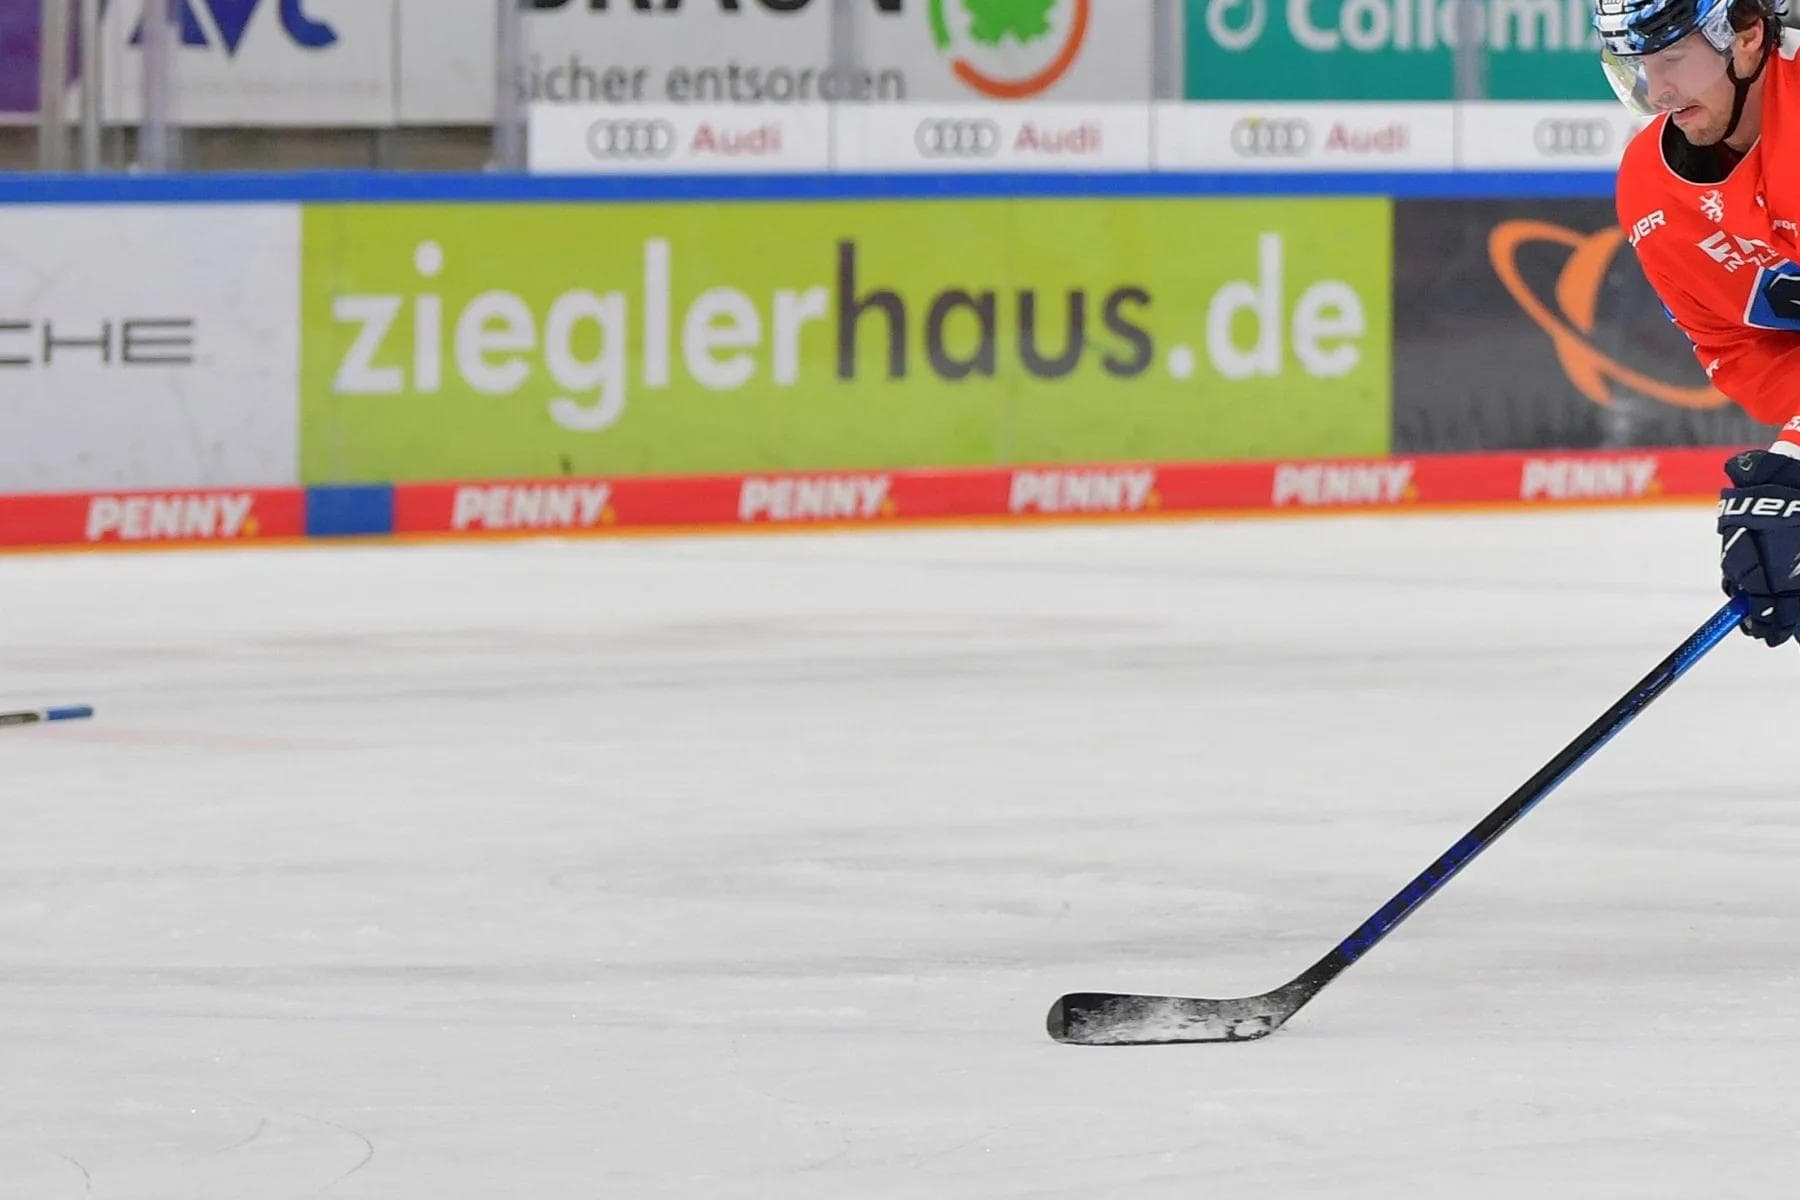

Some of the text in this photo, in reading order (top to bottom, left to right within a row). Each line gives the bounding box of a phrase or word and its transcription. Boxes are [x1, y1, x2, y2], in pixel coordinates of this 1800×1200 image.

[689, 121, 784, 156] Audi
[1013, 119, 1102, 155] Audi
[1325, 120, 1410, 154] Audi
[333, 232, 1366, 432] zieglerhaus.de
